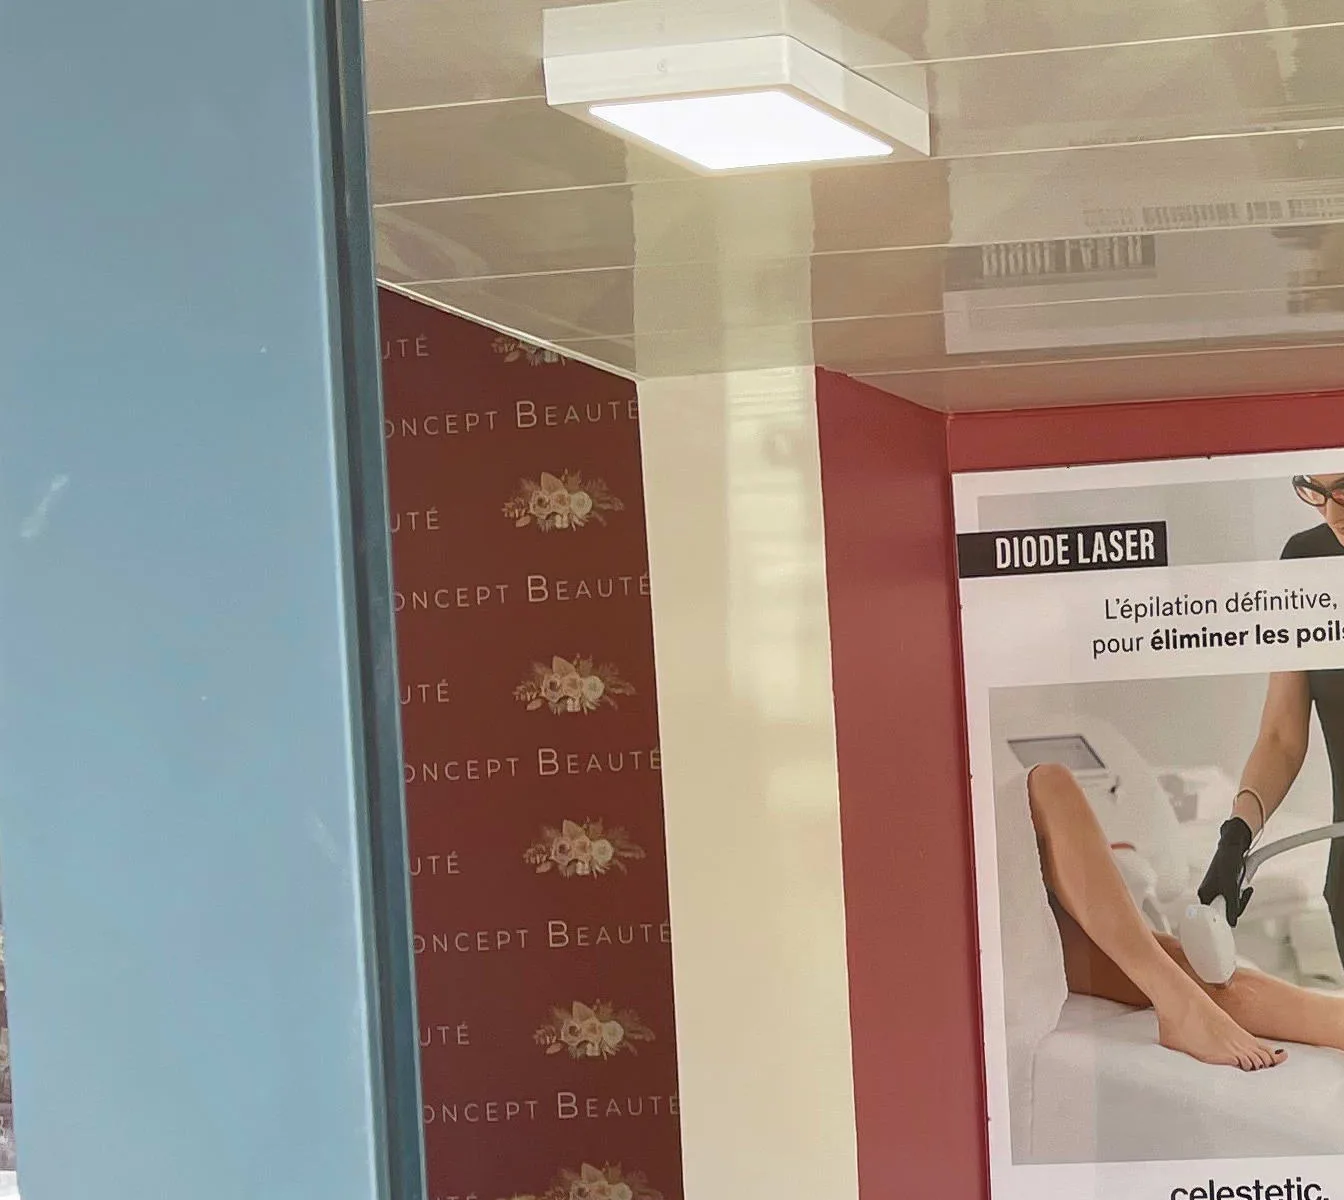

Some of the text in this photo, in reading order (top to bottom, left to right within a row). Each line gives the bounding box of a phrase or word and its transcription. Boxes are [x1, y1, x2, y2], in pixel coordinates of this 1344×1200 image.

[384, 410, 498, 438] ONCEPT
[390, 506, 441, 534] UTÉ
[994, 528, 1157, 570] DIODE LASER
[391, 584, 509, 612] ONCEPT
[1104, 588, 1339, 624] L'épilation définitive,
[1092, 634, 1144, 659] pour
[1150, 626, 1249, 651] éliminer
[1255, 624, 1289, 645] les
[400, 679, 450, 705] UTÉ
[403, 757, 520, 783] ONCEPT
[408, 851, 461, 876] UTÉ
[413, 929, 529, 954] ONCEPT
[417, 1023, 470, 1047] UTÉ
[423, 1100, 538, 1124] ONCEPT
